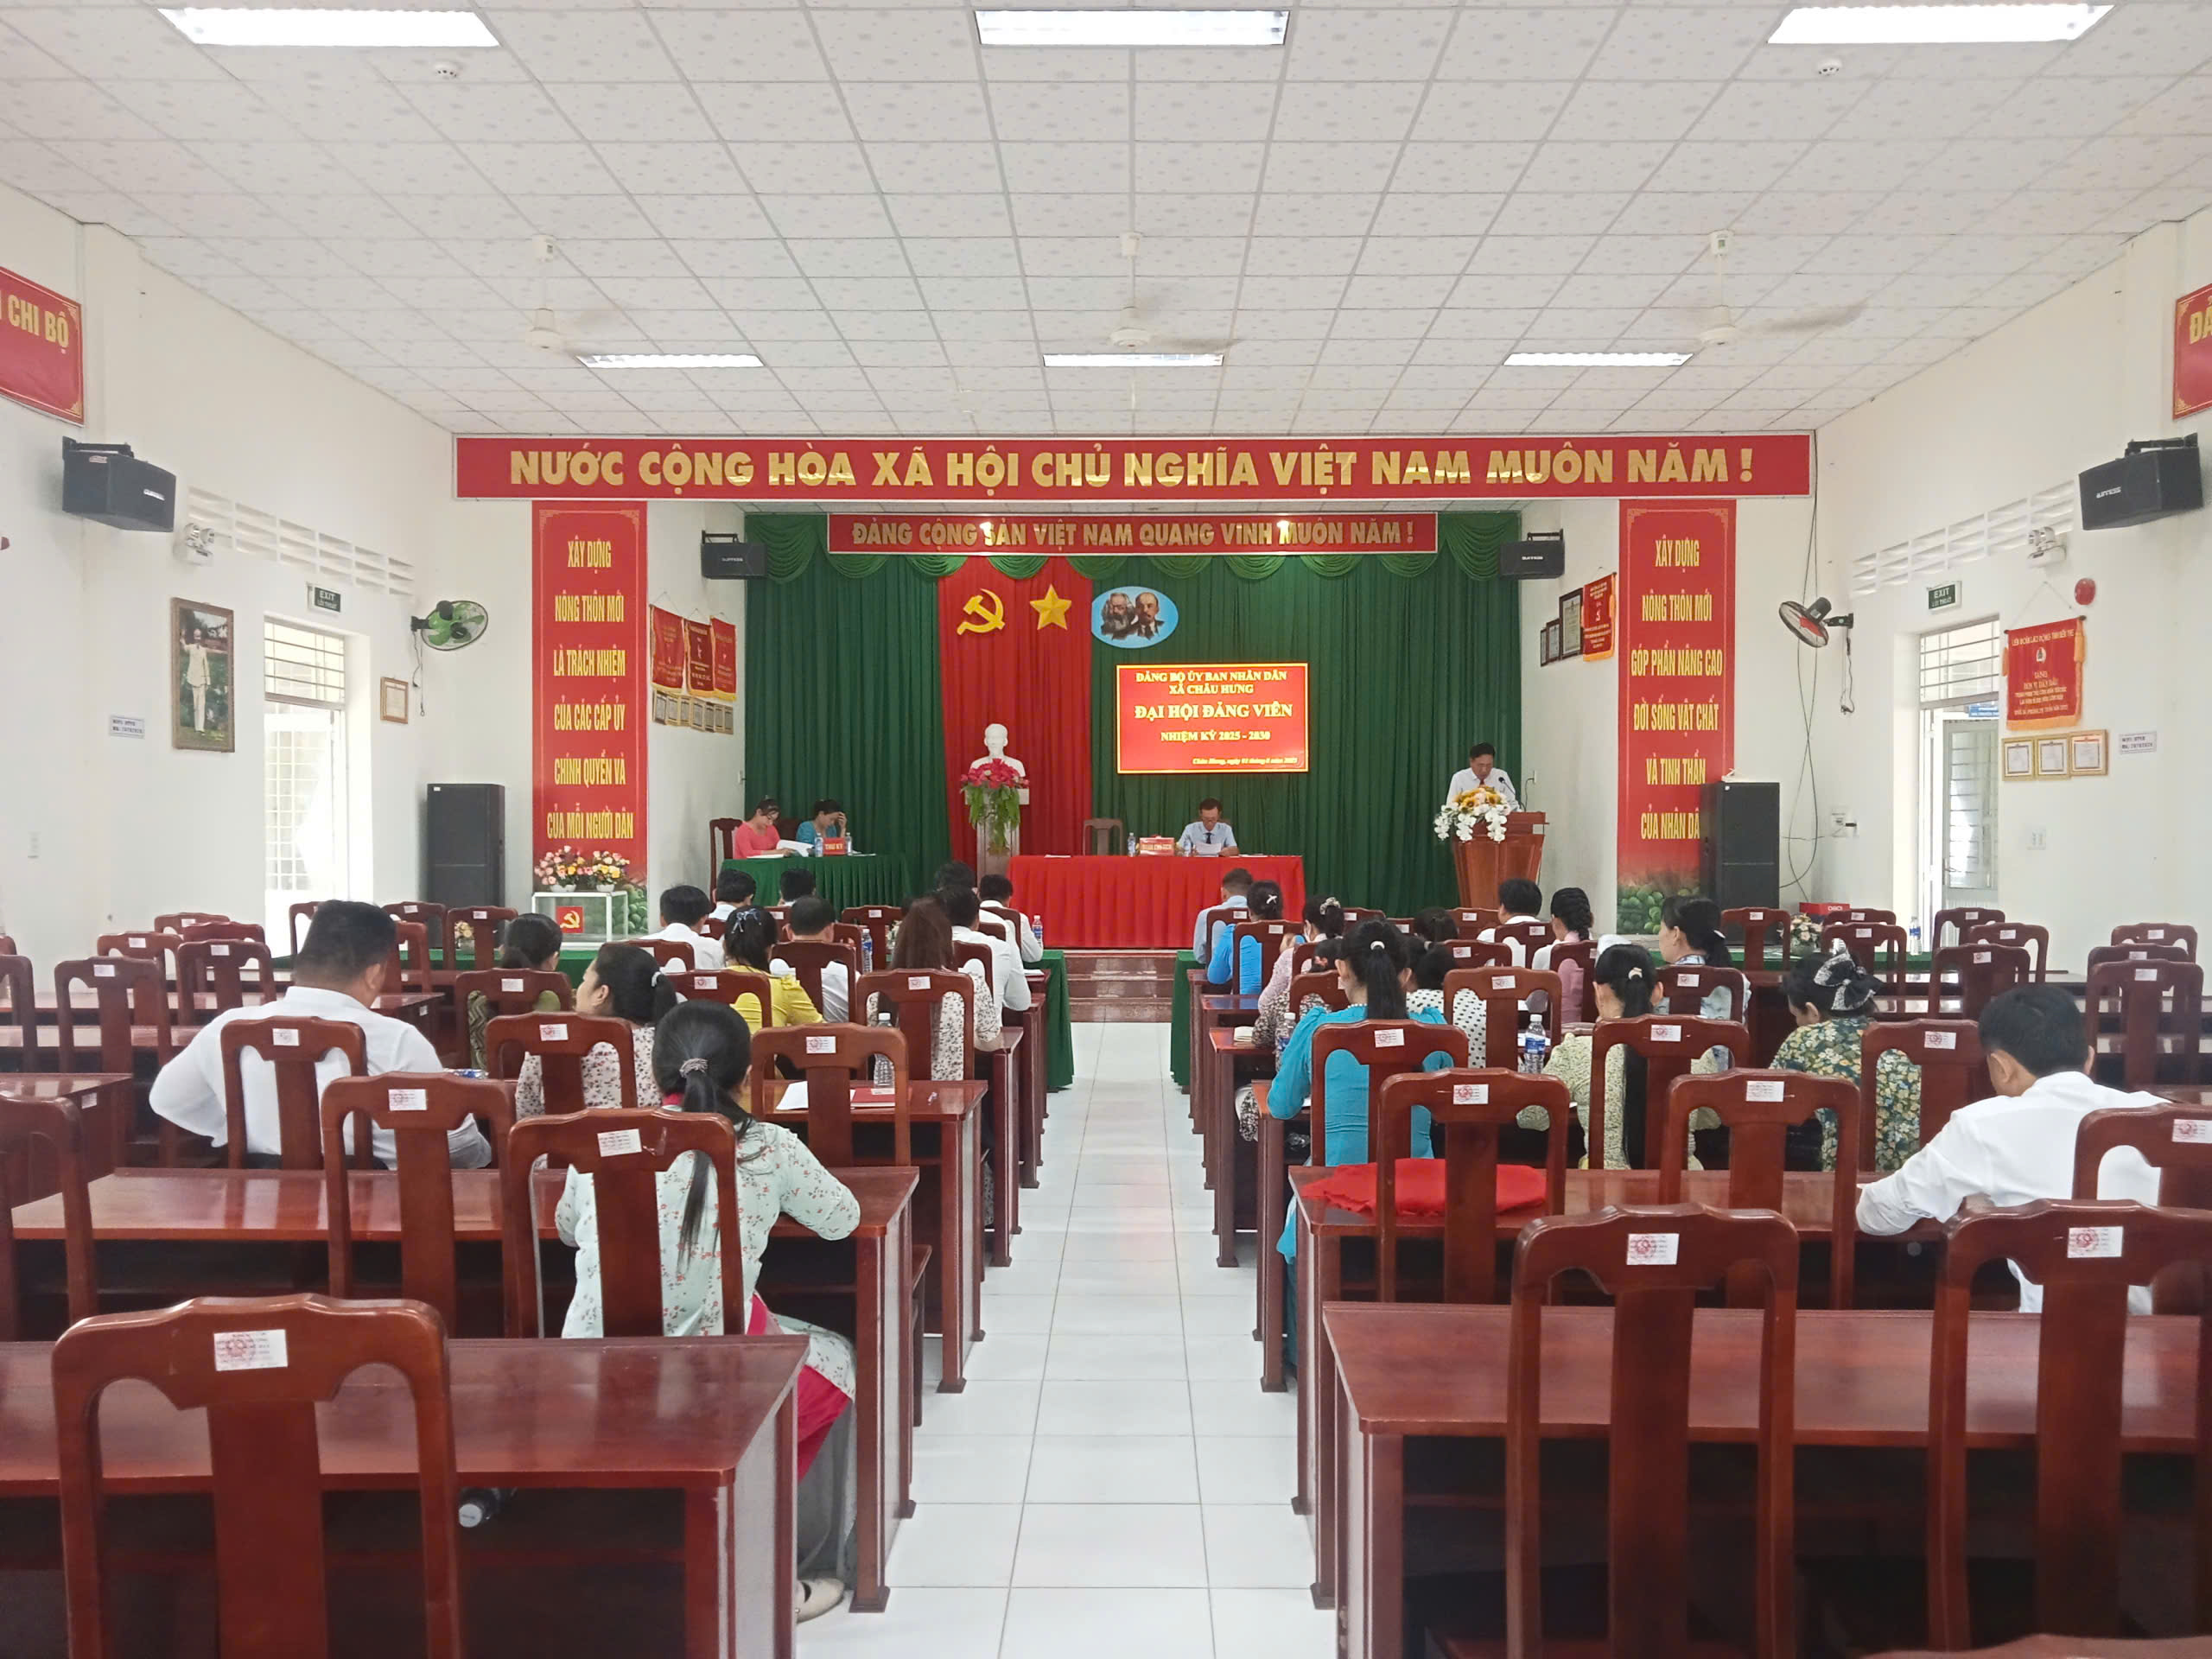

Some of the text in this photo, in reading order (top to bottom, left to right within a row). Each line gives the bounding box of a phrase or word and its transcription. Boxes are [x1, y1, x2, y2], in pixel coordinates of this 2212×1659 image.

[8, 294, 70, 355] CHI BỘ
[511, 441, 1752, 496] NƯỚC CỘNG HÒA XÃ HỘI CHỦ NGHĨA VIỆT NAM MUÔN NĂM !
[852, 517, 1414, 551] ĐẢNG CỘNG SẢN VIỆT NAM QUANG VINH MUÔN NĂM !
[568, 534, 612, 575] XÂY DỰNG
[1655, 534, 1700, 573] XÂY DỰNG
[320, 590, 336, 601] EXIT
[555, 589, 625, 622] NÔNG THÔN MỚI
[1642, 588, 1668, 622] NÔNG
[1669, 588, 1693, 622] THÔN
[1694, 588, 1713, 622] MỚI
[1934, 588, 1950, 599] EXIT
[553, 644, 565, 677] LÀ
[567, 644, 595, 677] TRÁCH
[596, 644, 626, 683] NHIỆM
[1205, 671, 1229, 682] BAN
[1630, 639, 1723, 677] GÓP PHẦN NÂNG CAO
[554, 694, 626, 731] CỦA CÁC CẤP ỦY
[1135, 701, 1293, 721] ĐẠI HỘI ĐẢNG VIÊN
[1633, 694, 1719, 737] ĐỜI SỐNG VẬT CHẤT
[554, 748, 626, 789] CHÍNH QUYỀN VÀ
[1646, 752, 1658, 785] VÀ
[1660, 758, 1681, 785] TINH
[547, 802, 634, 839] CỦA MỖI NGƯỜI DÂN
[1641, 803, 1700, 840] CỦA NHÂN DÂ
